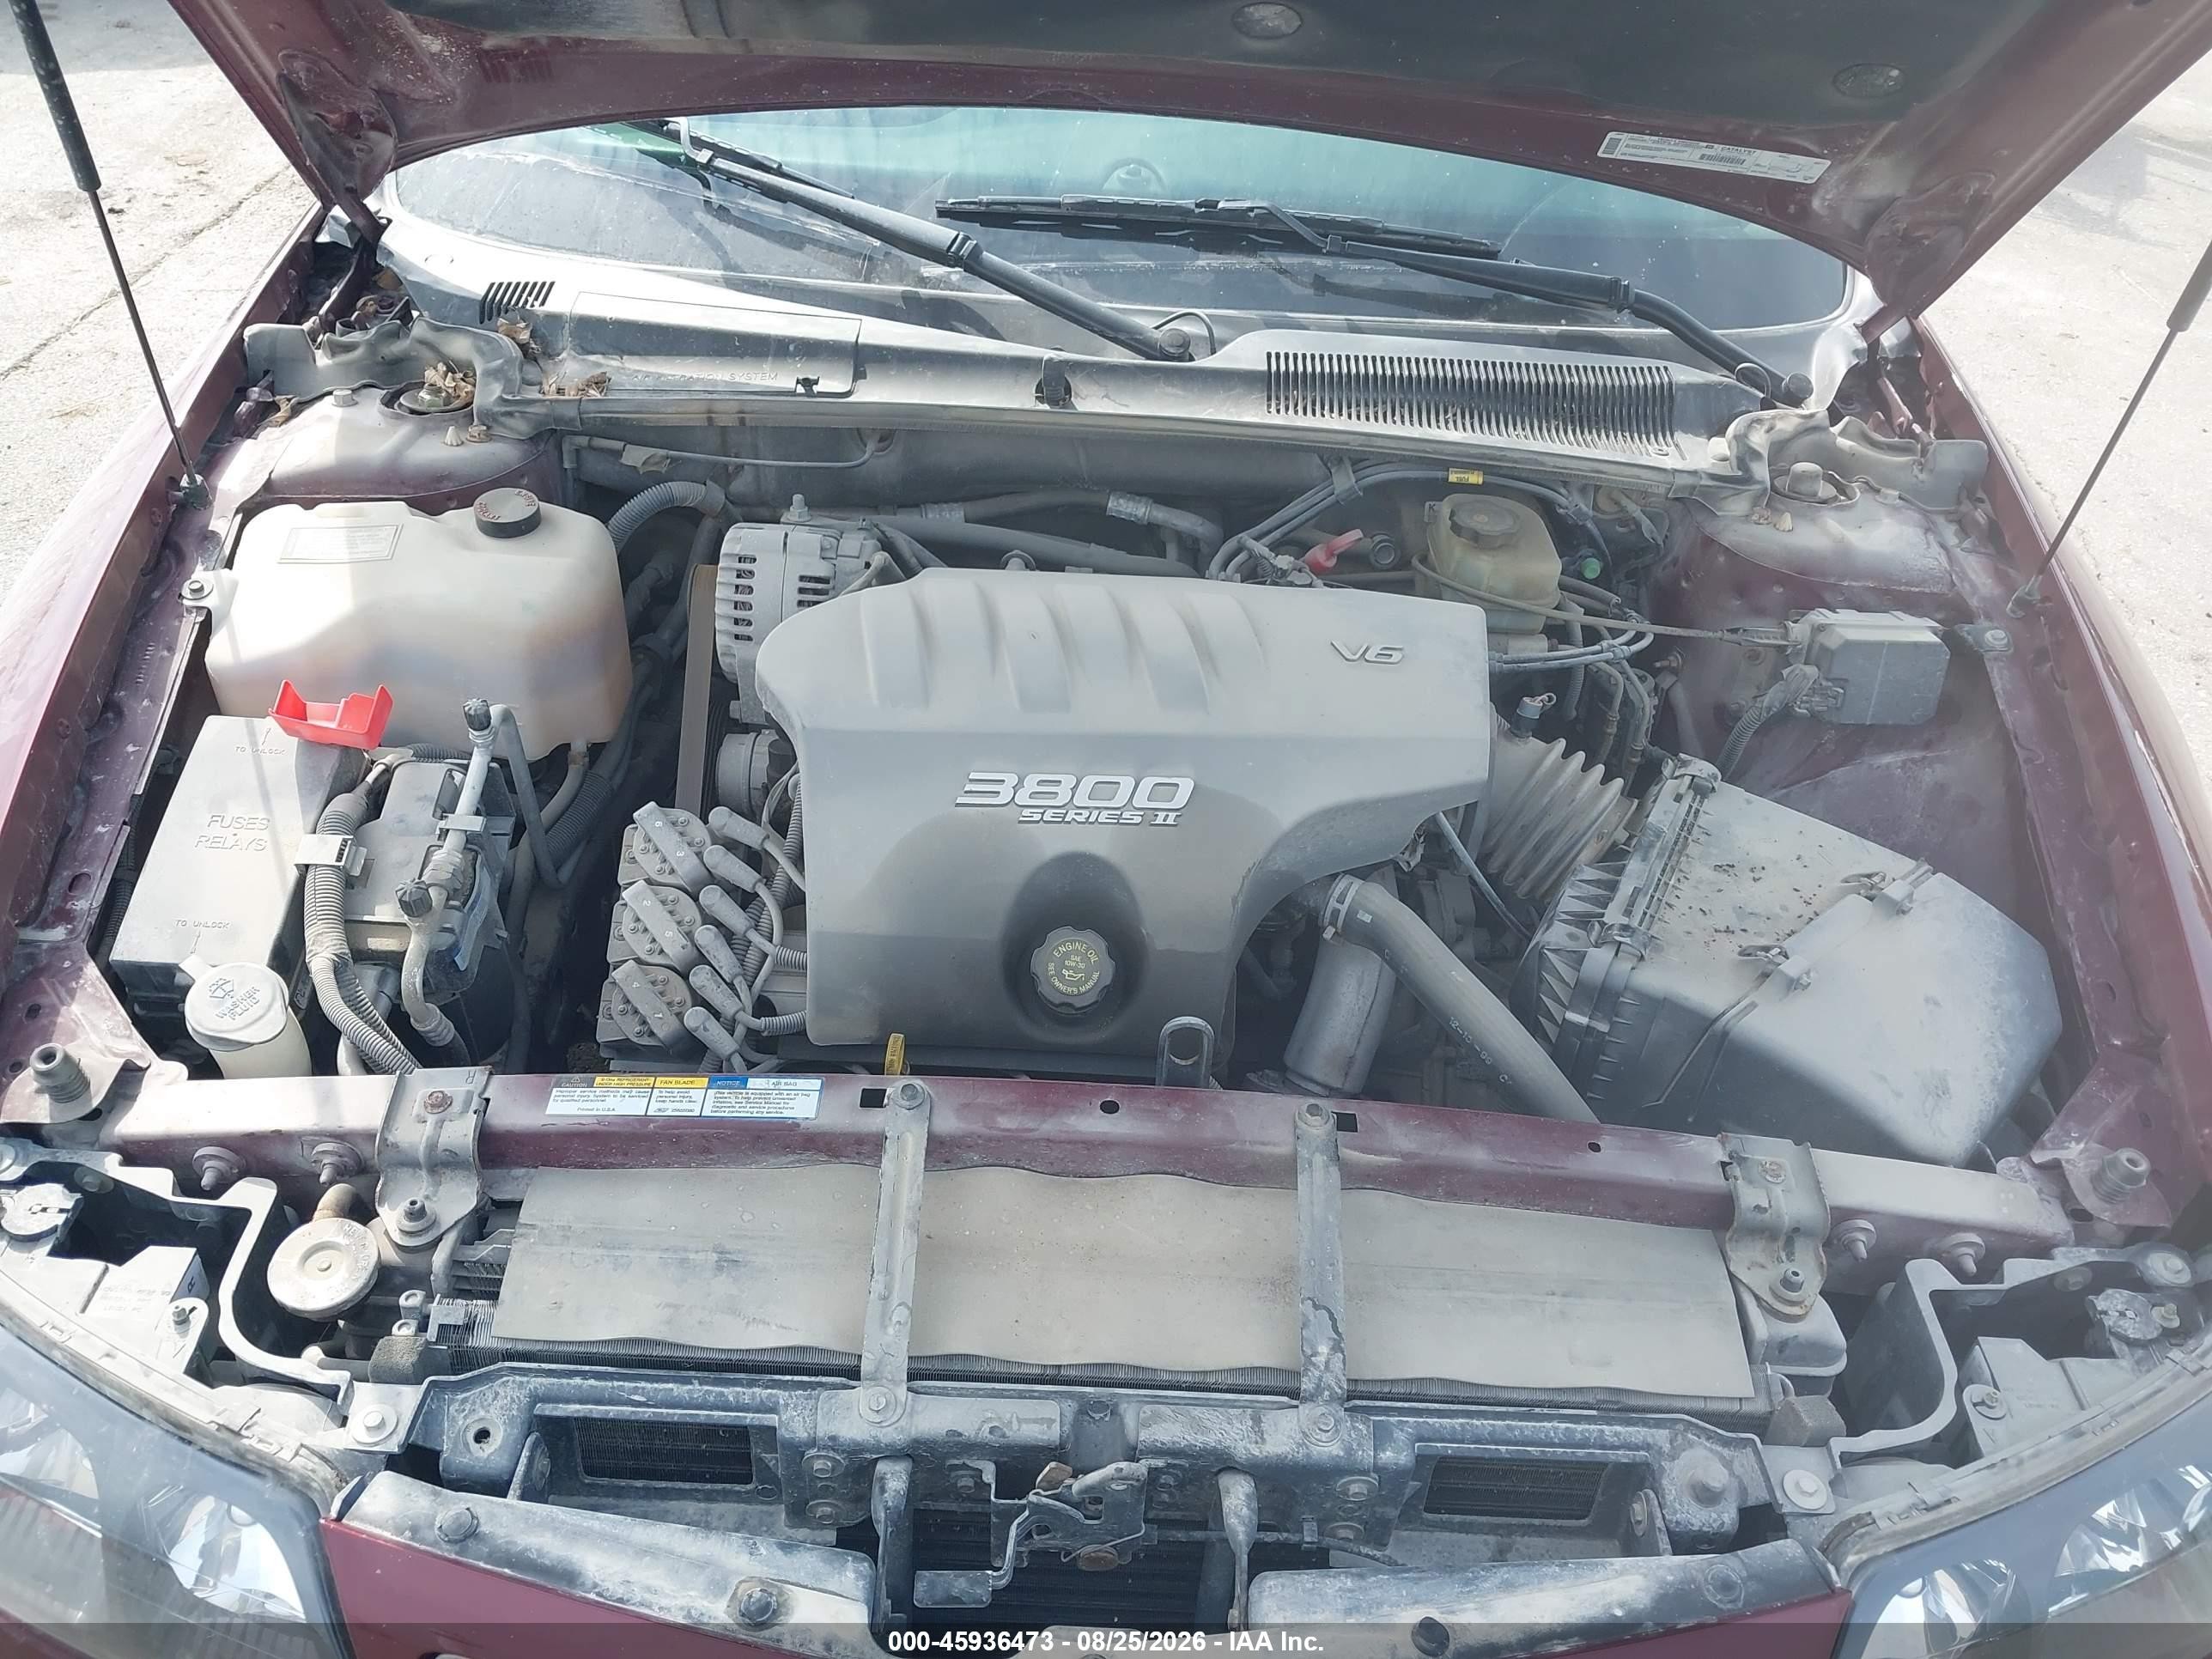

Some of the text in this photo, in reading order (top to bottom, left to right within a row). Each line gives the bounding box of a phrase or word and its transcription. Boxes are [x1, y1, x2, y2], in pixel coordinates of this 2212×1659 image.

[1720, 146, 1757, 155] CATALYST
[728, 372, 778, 381] SYSTEM
[1330, 640, 1404, 665] V6
[234, 745, 288, 755] TO UNLOCK
[955, 771, 1195, 810] 3800
[207, 814, 270, 830] FUSES
[1018, 809, 1145, 825] SERIES
[194, 835, 269, 852] RELAYS
[642, 899, 652, 908] 2
[174, 919, 231, 929] TO UNLOCK
[1053, 942, 1099, 965] ENGINE OIL
[1064, 960, 1085, 969] 10W-30
[1050, 976, 1078, 994] OWNER'S
[1079, 970, 1100, 994] MANUAL
[216, 987, 260, 1019] WASHER
[228, 998, 260, 1020] FLUID
